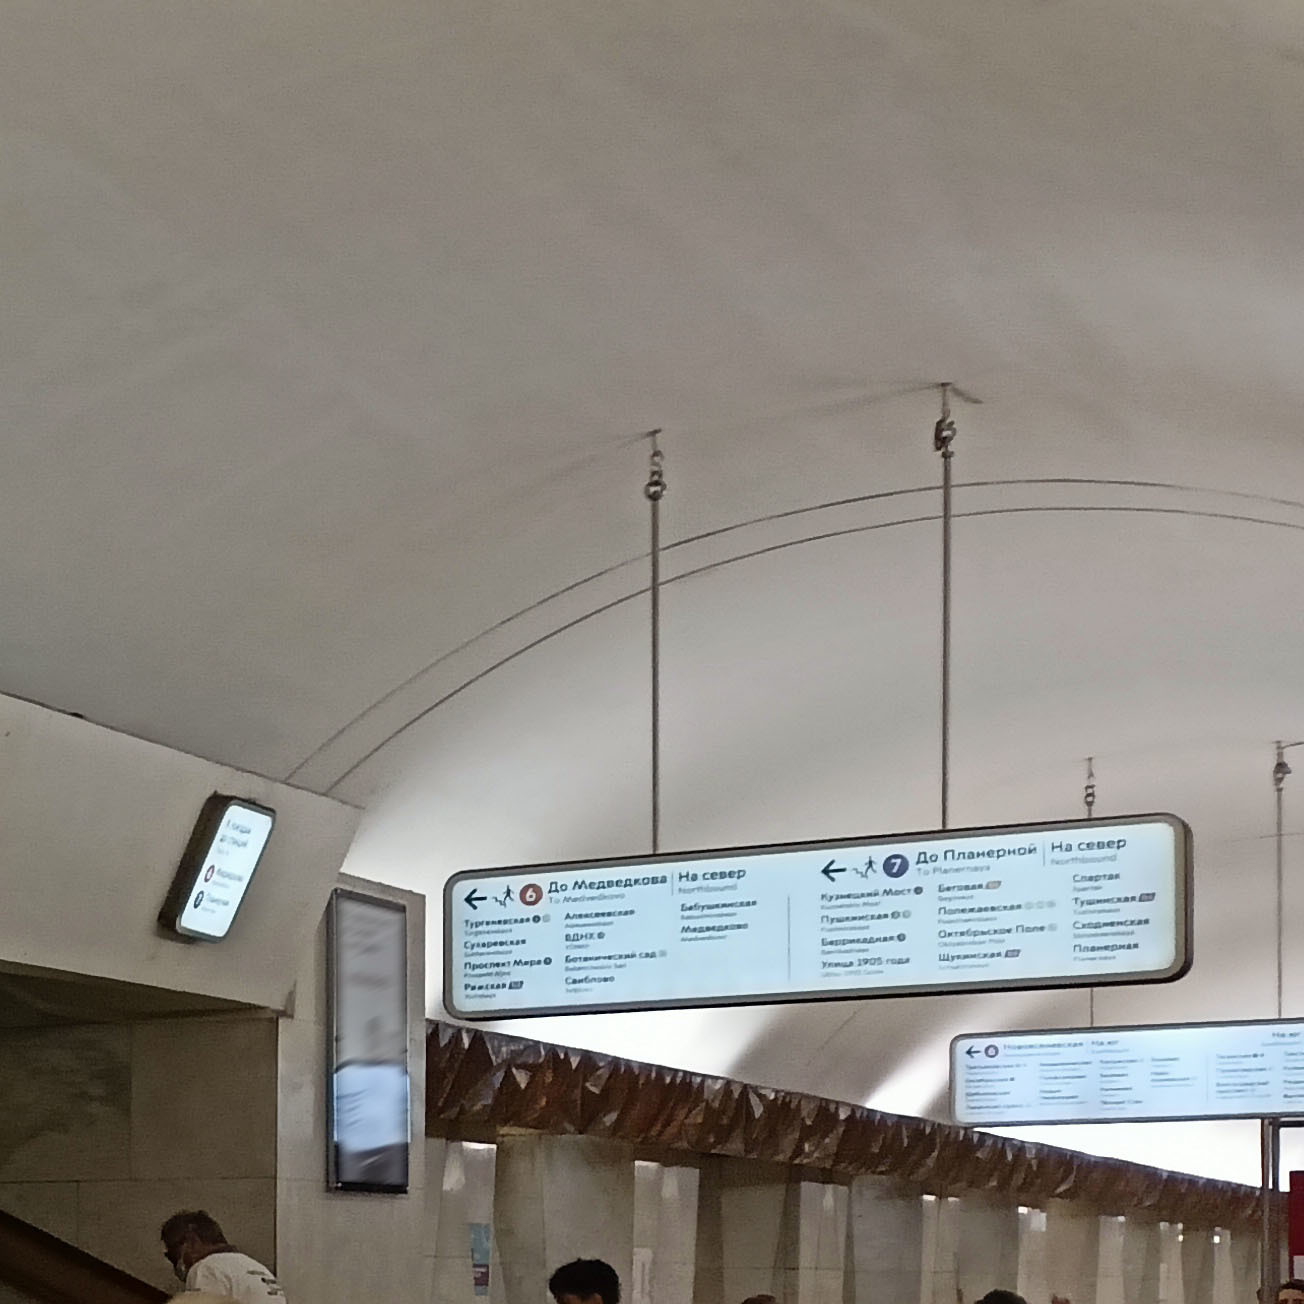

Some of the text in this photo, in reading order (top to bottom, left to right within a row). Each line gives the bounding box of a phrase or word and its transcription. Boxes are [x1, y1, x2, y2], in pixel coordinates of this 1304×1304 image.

[1051, 839, 1127, 852] На север
[916, 845, 1037, 865] До Планерной
[678, 869, 747, 882] На север
[547, 874, 668, 894] До Медведкова
